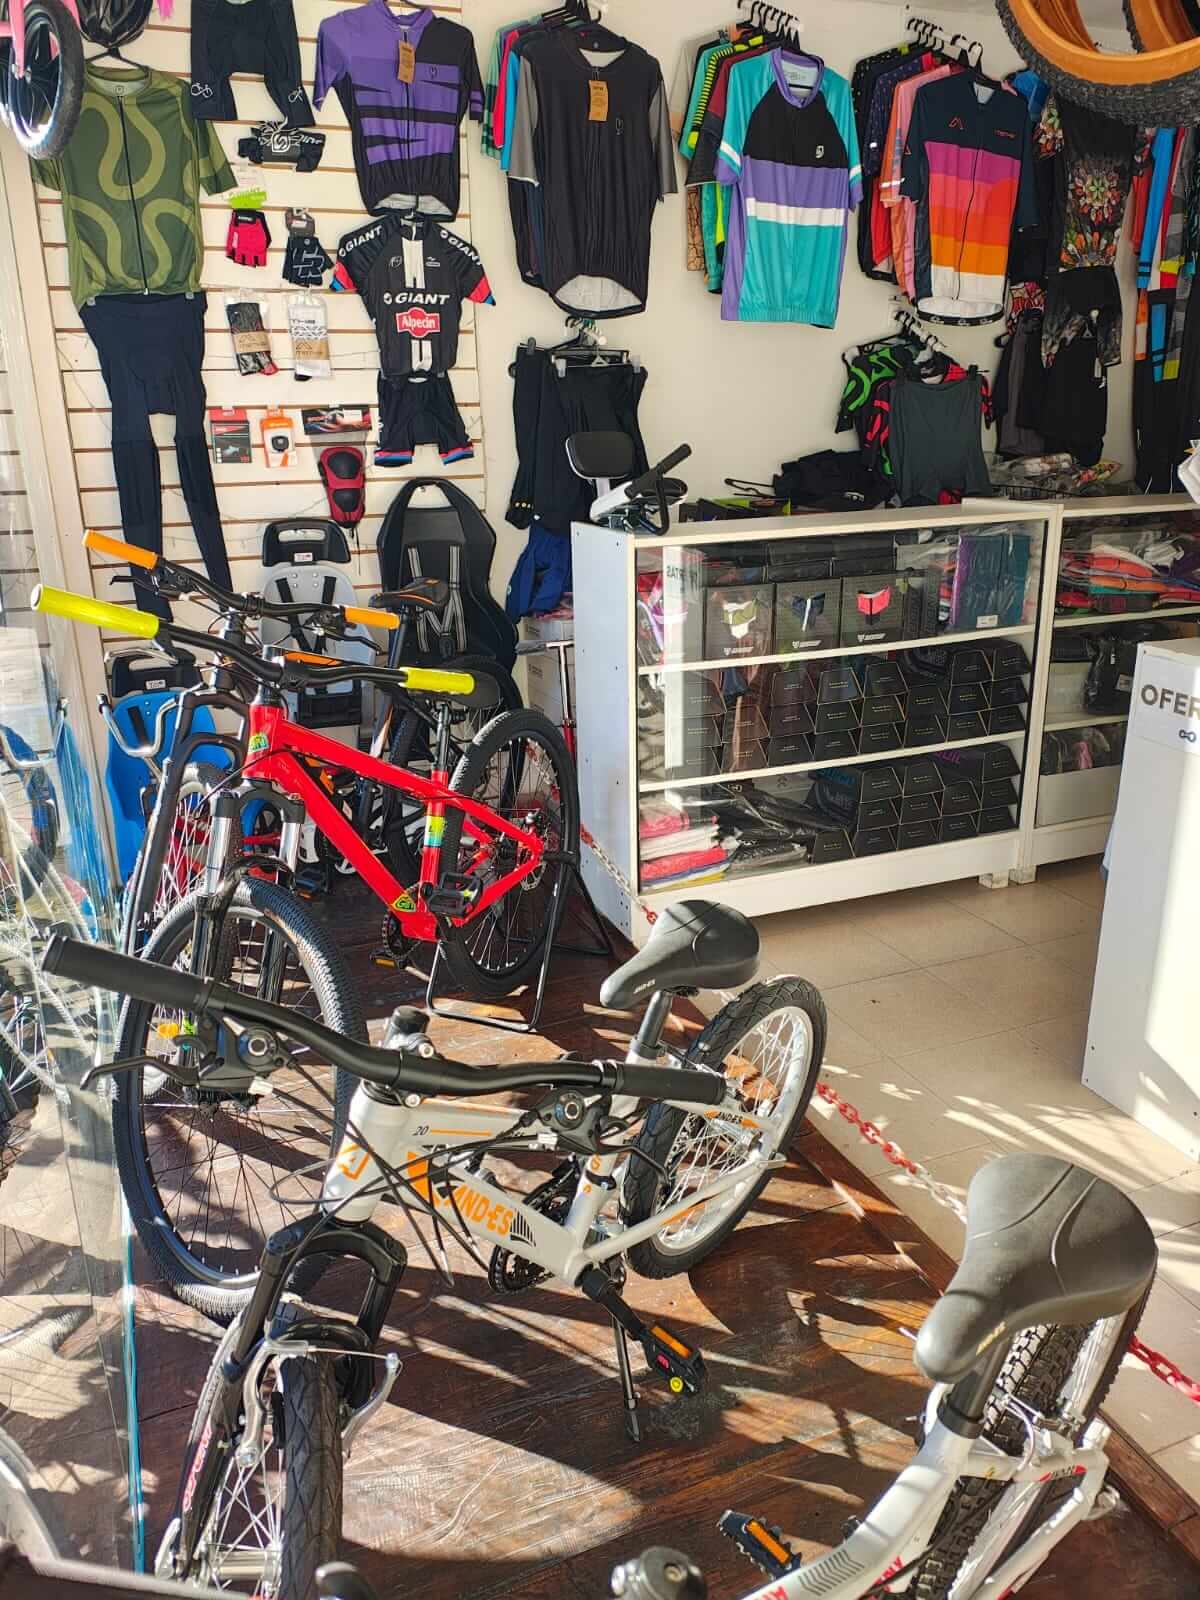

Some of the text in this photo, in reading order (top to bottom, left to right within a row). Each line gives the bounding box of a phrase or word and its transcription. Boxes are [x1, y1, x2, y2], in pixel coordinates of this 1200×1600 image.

[345, 225, 383, 252] GIANT
[395, 292, 450, 305] GIANT
[401, 315, 436, 330] Alpecin
[1141, 684, 1200, 720] OFER
[412, 1125, 429, 1136] 20
